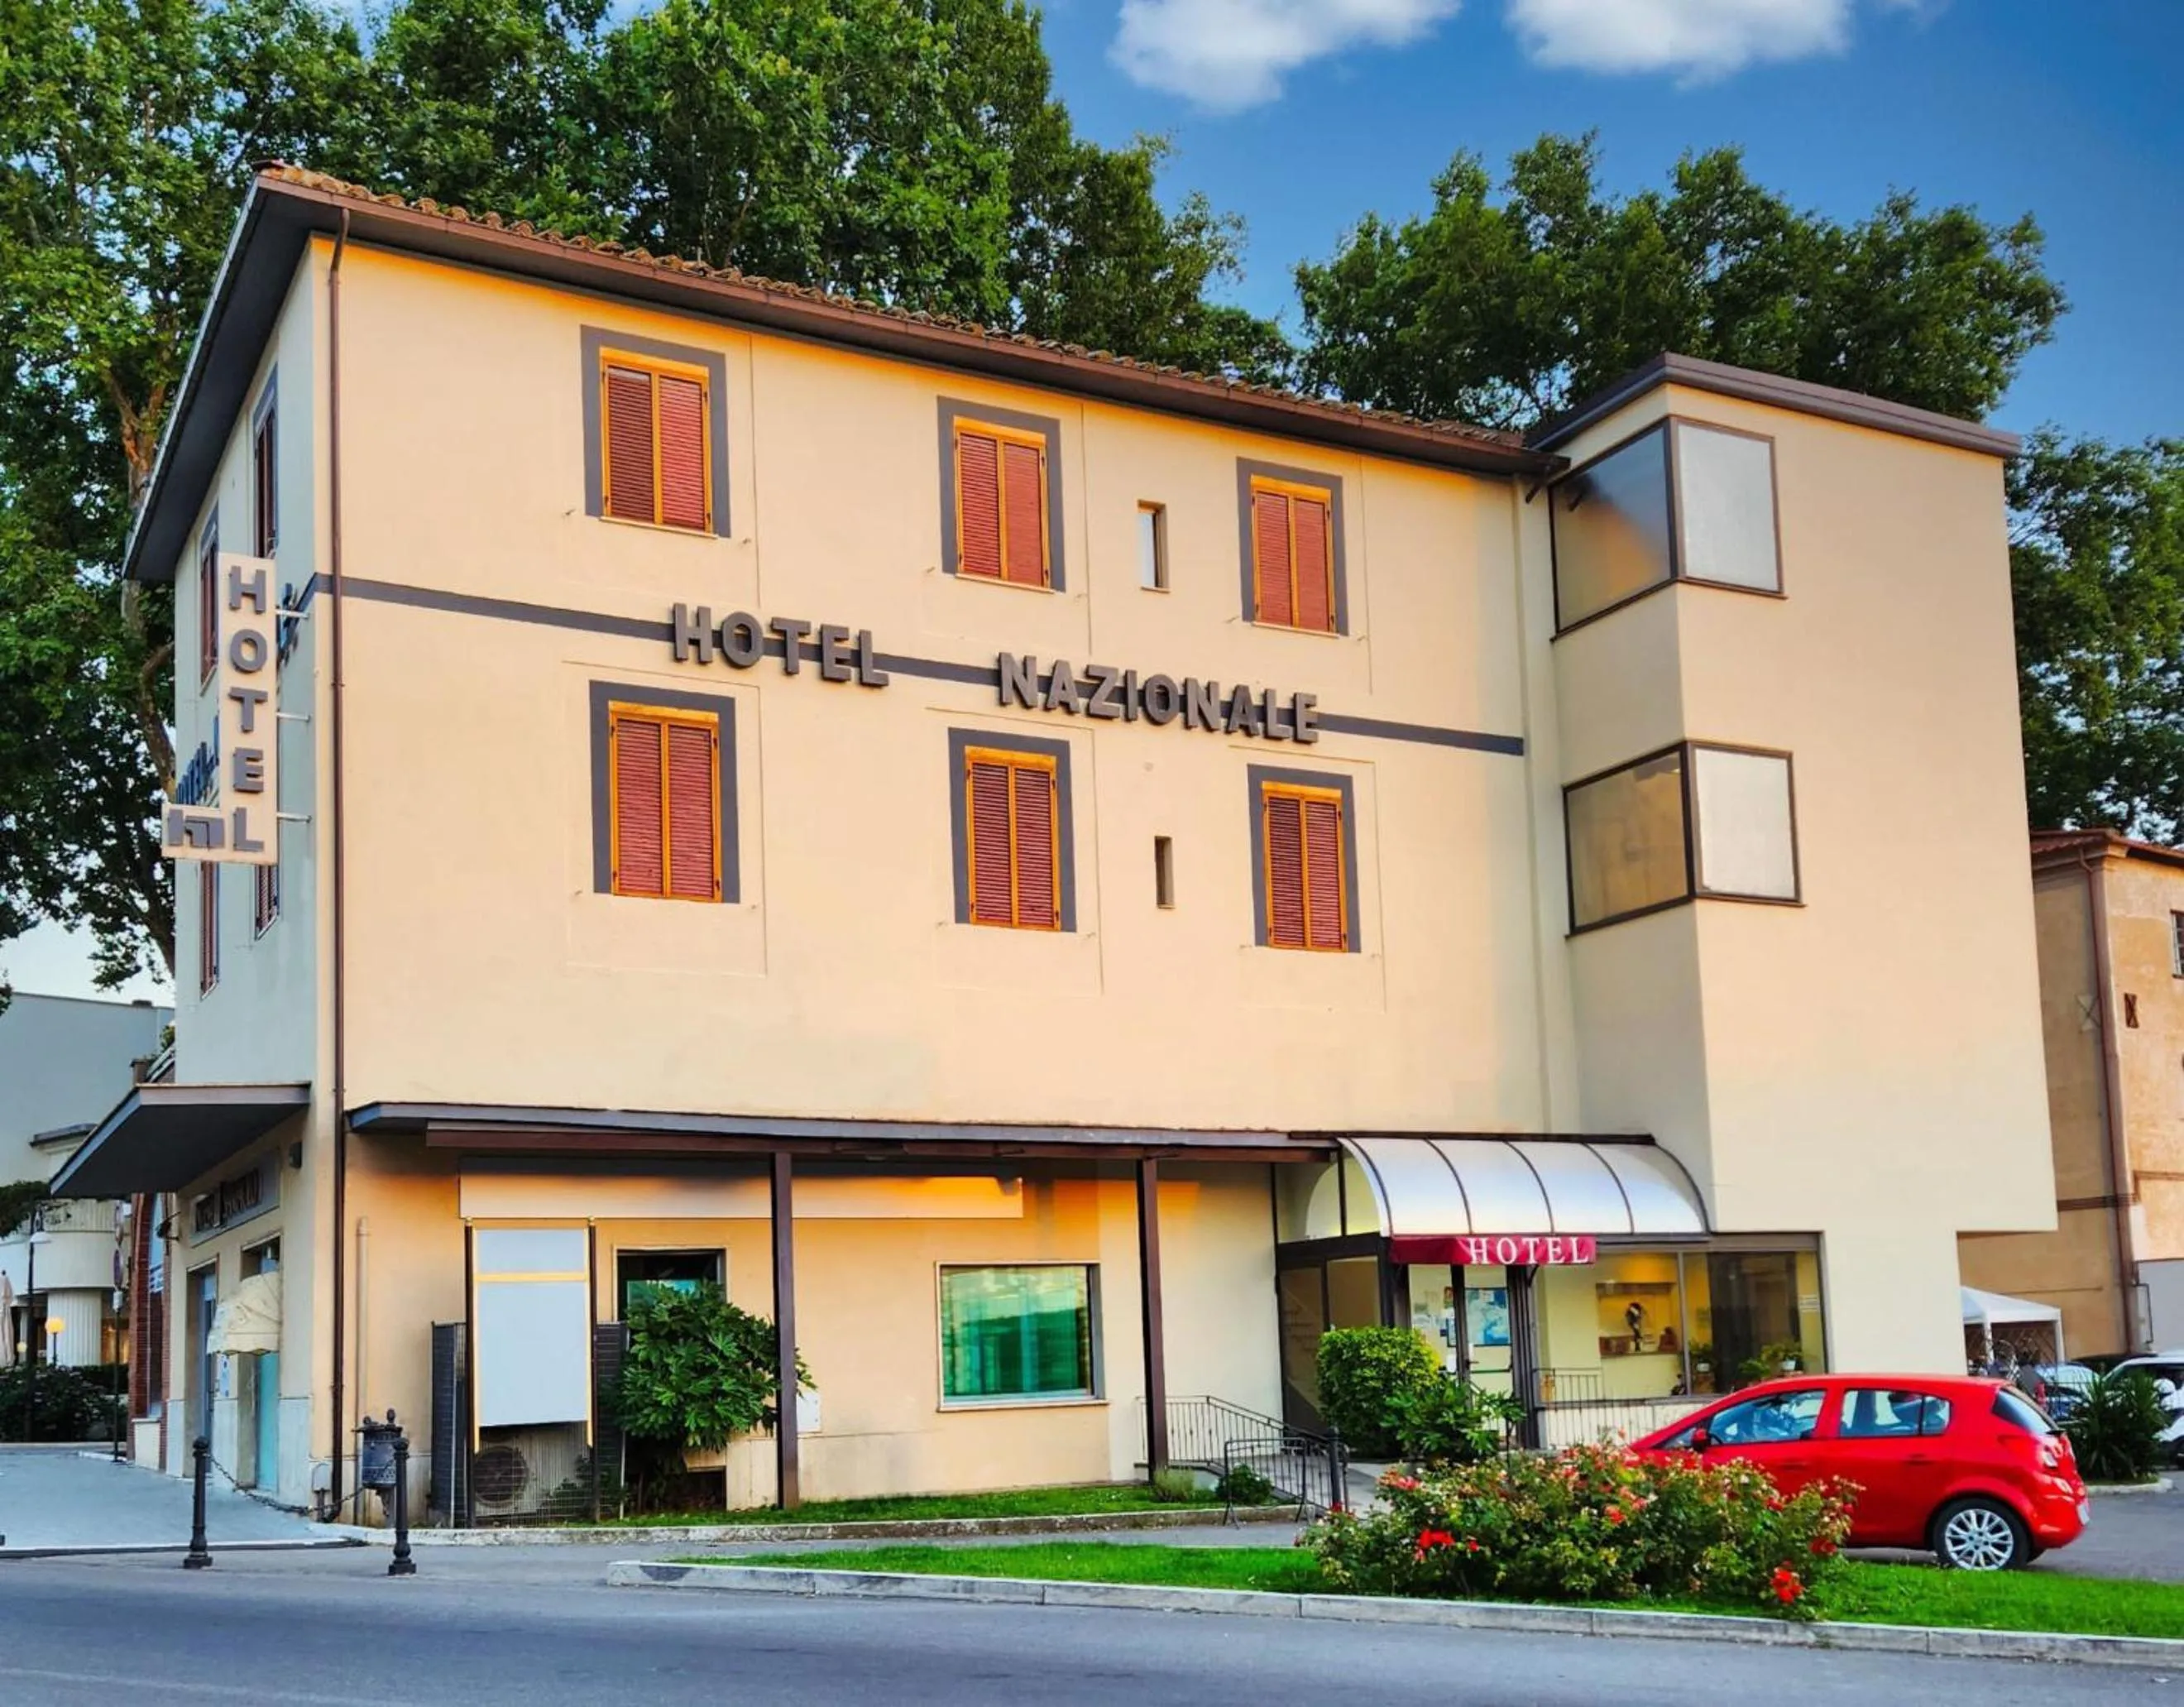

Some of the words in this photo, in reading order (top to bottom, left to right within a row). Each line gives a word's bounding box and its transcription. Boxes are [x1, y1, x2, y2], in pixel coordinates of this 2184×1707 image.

[228, 565, 269, 852] HOTEL
[673, 602, 889, 687] HOTEL
[998, 652, 1319, 744] NAZIONALE
[1467, 1236, 1589, 1264] HOTEL
